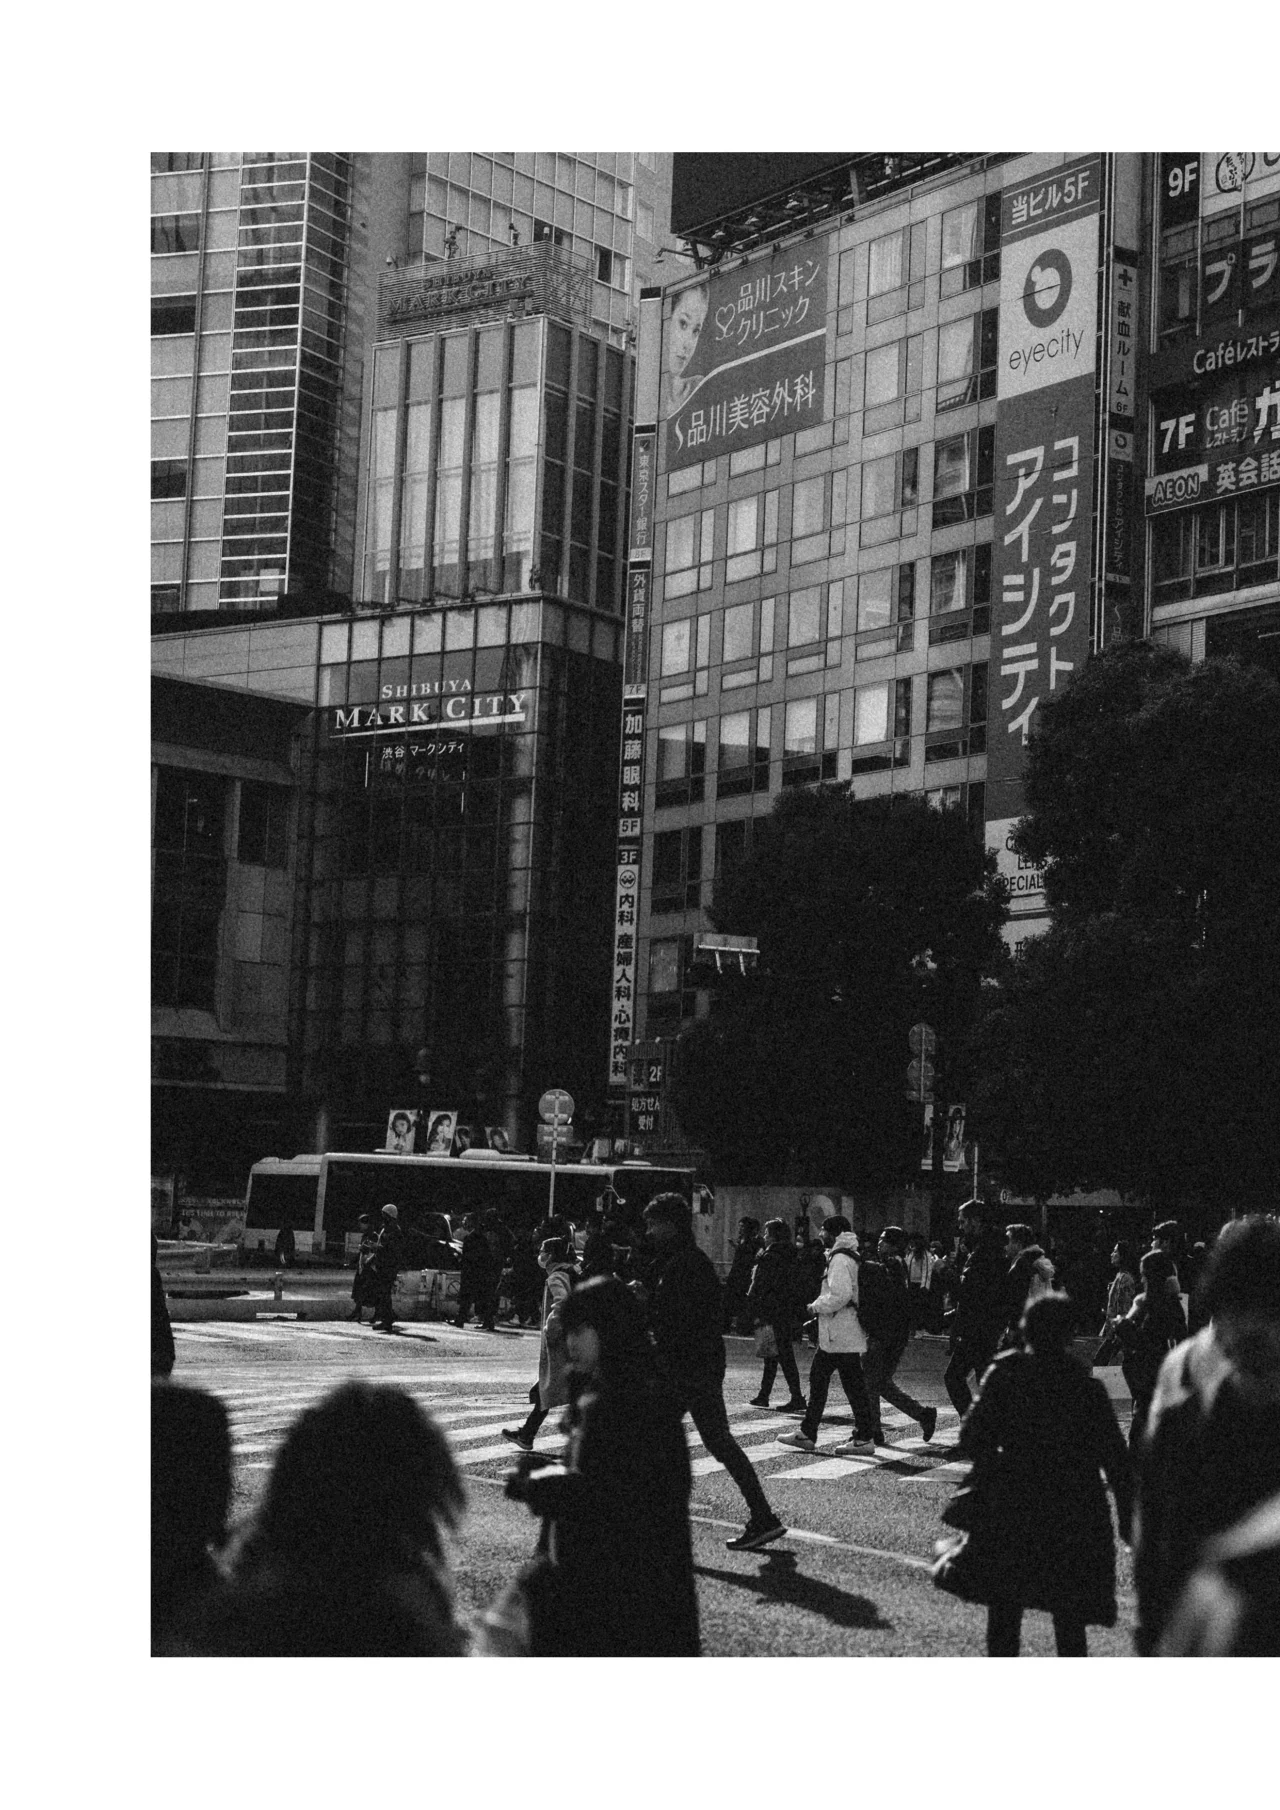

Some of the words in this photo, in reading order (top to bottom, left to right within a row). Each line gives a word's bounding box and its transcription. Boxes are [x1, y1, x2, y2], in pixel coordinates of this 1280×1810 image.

[1011, 170, 1091, 227] 当ビル5F
[1168, 162, 1198, 198] 9F
[388, 287, 461, 315] MARK
[466, 275, 533, 299] CITY
[736, 259, 822, 314] 品川スキン
[737, 295, 811, 346] クリニック
[1008, 329, 1086, 376] eyecity
[686, 371, 817, 450] 品川美容外科
[1205, 398, 1249, 433] Café
[1160, 413, 1196, 454] 7F
[635, 454, 649, 545] 東京スター銀行
[1153, 474, 1199, 503] AEON
[1049, 435, 1080, 690] コンタクト
[632, 574, 647, 633] 外貨両替
[1001, 445, 1045, 746] アイシティ
[381, 678, 474, 700] SHIBUYA
[335, 702, 431, 729] MARK
[445, 693, 527, 720] CITY
[410, 741, 465, 757] マークシティ
[621, 713, 643, 812] 加藤眼科
[621, 818, 639, 835] 5F
[620, 851, 637, 865] 3F
[618, 892, 635, 927] 内科
